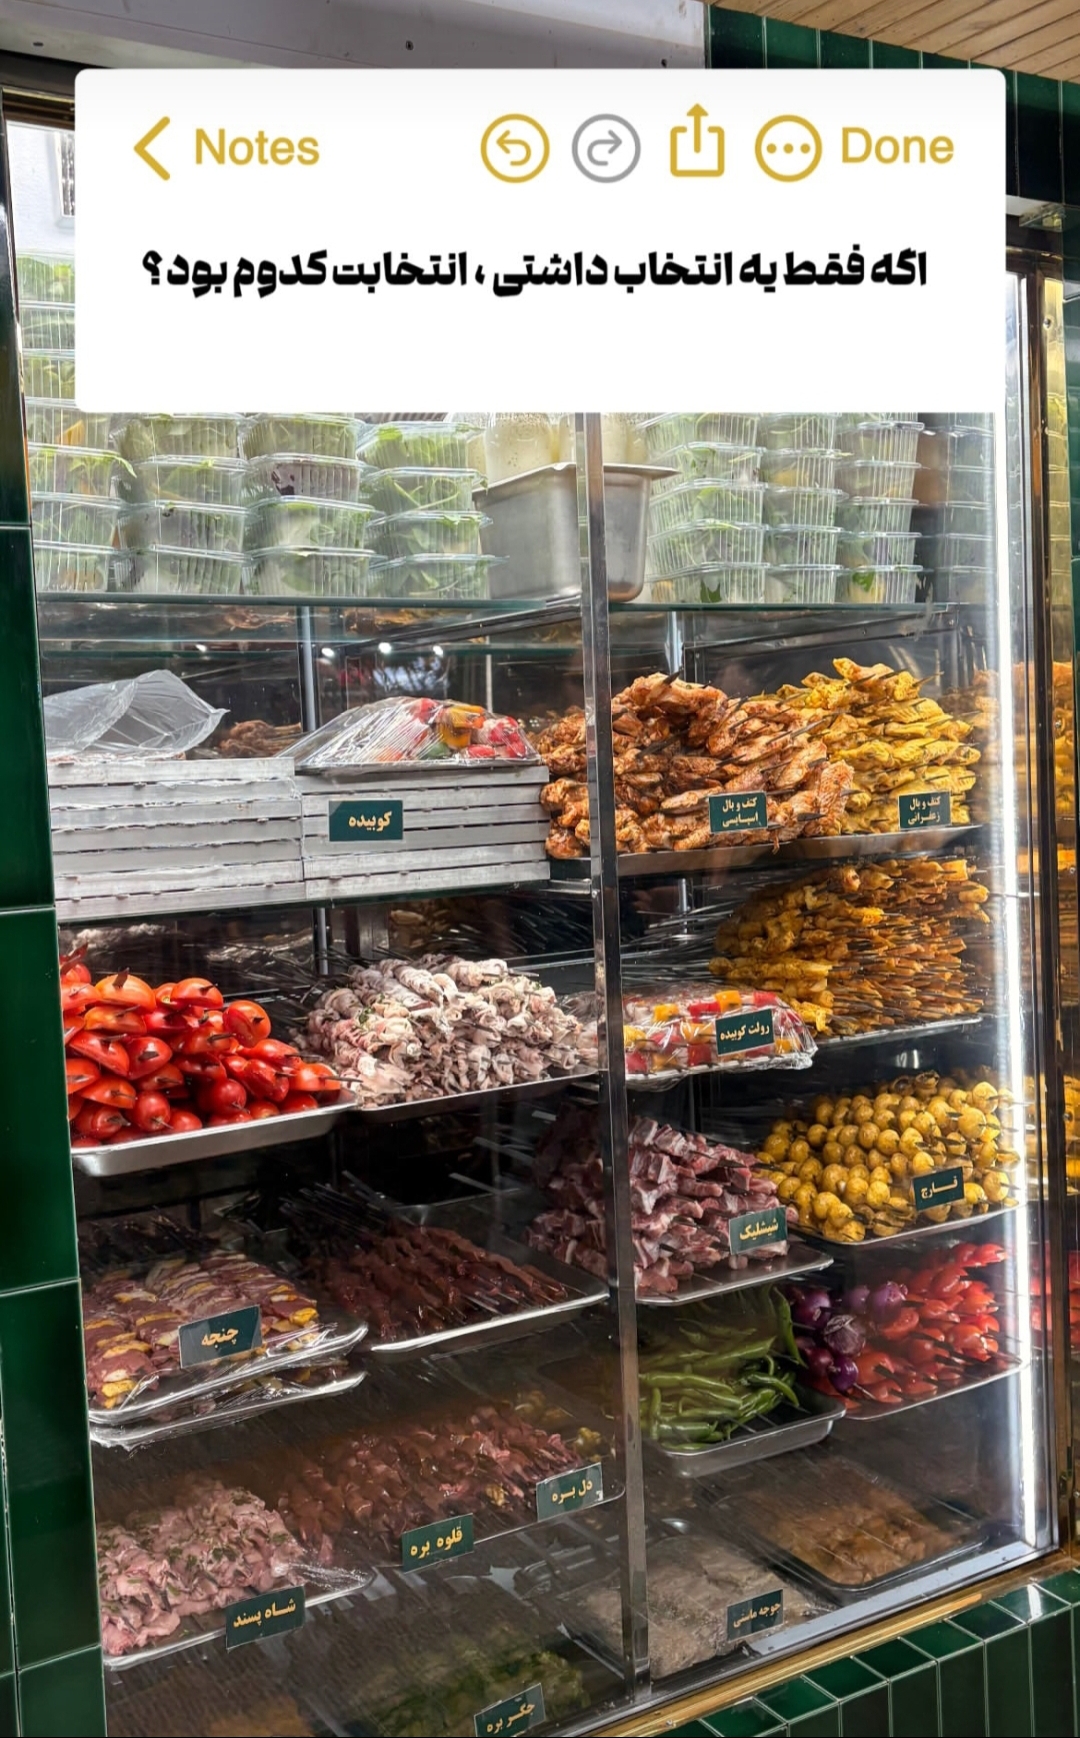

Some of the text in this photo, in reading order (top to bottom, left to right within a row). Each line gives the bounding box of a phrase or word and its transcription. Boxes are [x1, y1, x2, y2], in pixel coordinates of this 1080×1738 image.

[722, 796, 758, 813] کتف و بال
[909, 795, 941, 812] کتف و بال
[348, 810, 393, 832] کوبیده
[722, 811, 759, 828] اسپایسی
[907, 811, 941, 826] زعفرانی
[720, 1021, 770, 1041] رولت کوبیده
[739, 1217, 779, 1241] شیشلیک
[201, 1327, 239, 1349] چنجه
[551, 1479, 593, 1505] دل بره
[410, 1526, 463, 1559] قلوه بره
[233, 1598, 297, 1628] شاه پسند
[758, 1602, 781, 1617] جوجه
[486, 1717, 504, 1735] بره
